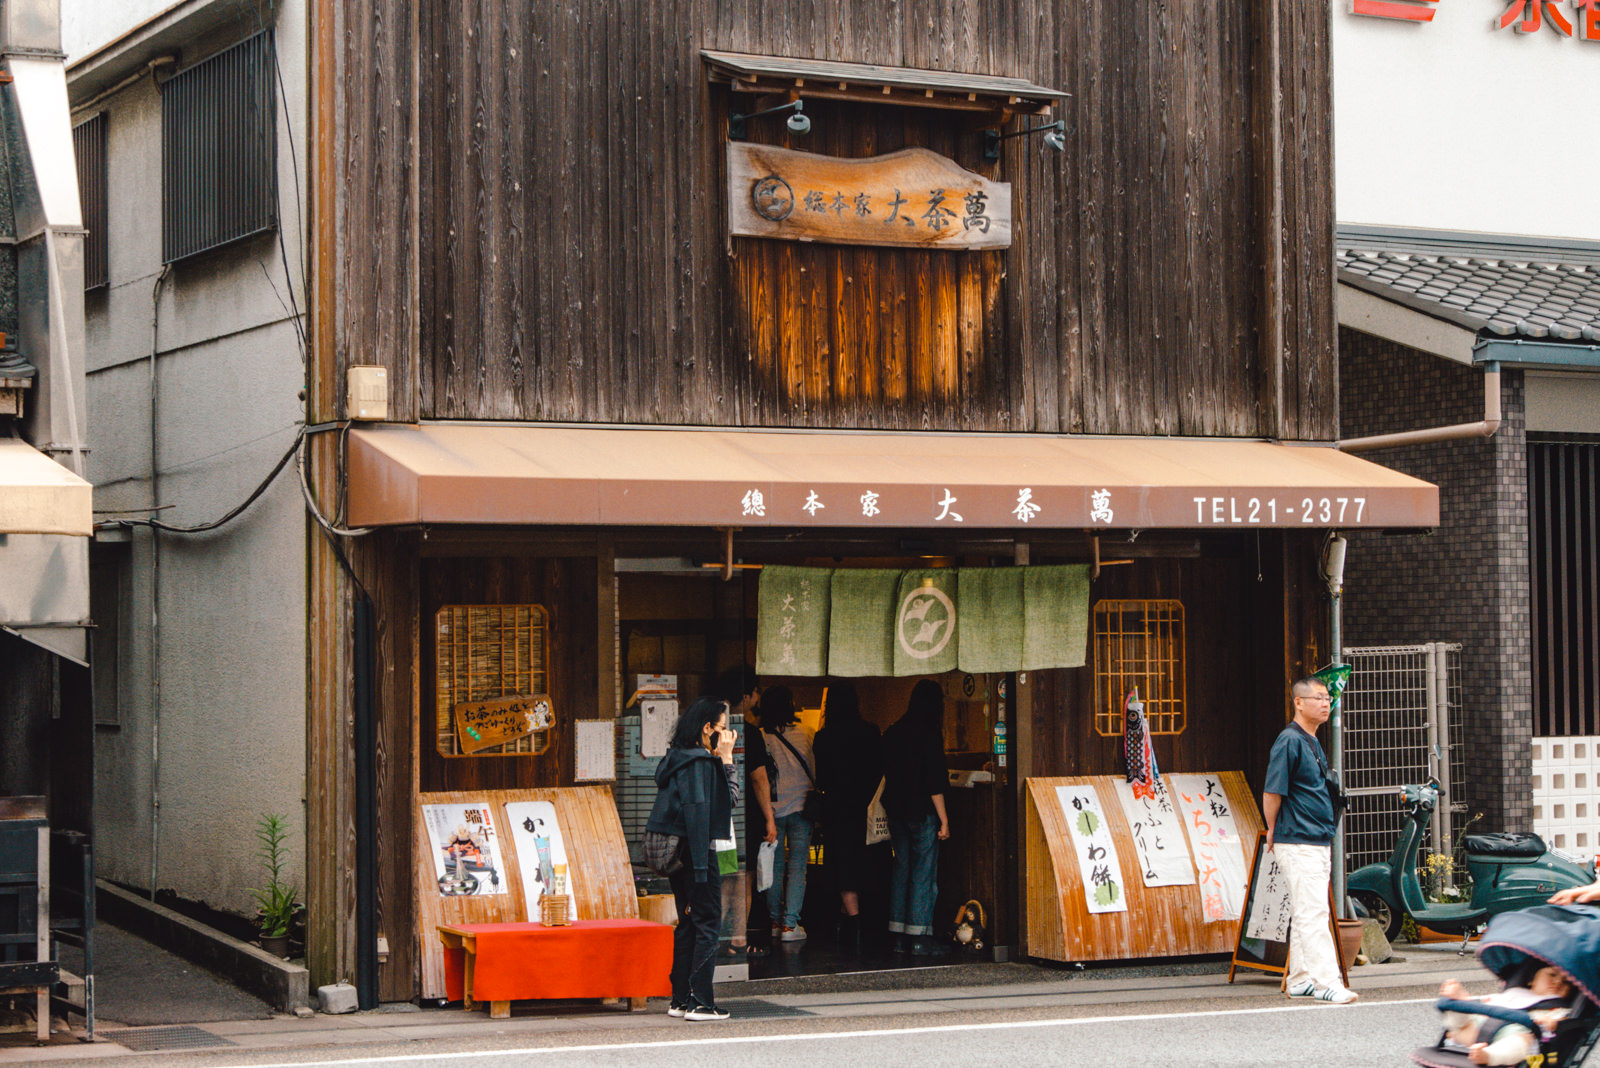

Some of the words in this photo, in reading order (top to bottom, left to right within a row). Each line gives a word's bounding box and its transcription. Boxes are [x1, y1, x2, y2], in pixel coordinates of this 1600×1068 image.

[1206, 780, 1230, 818] 大粒
[1071, 795, 1116, 901] かしわ餅
[1133, 821, 1159, 879] クリーム
[1181, 792, 1225, 919] いちご大福
